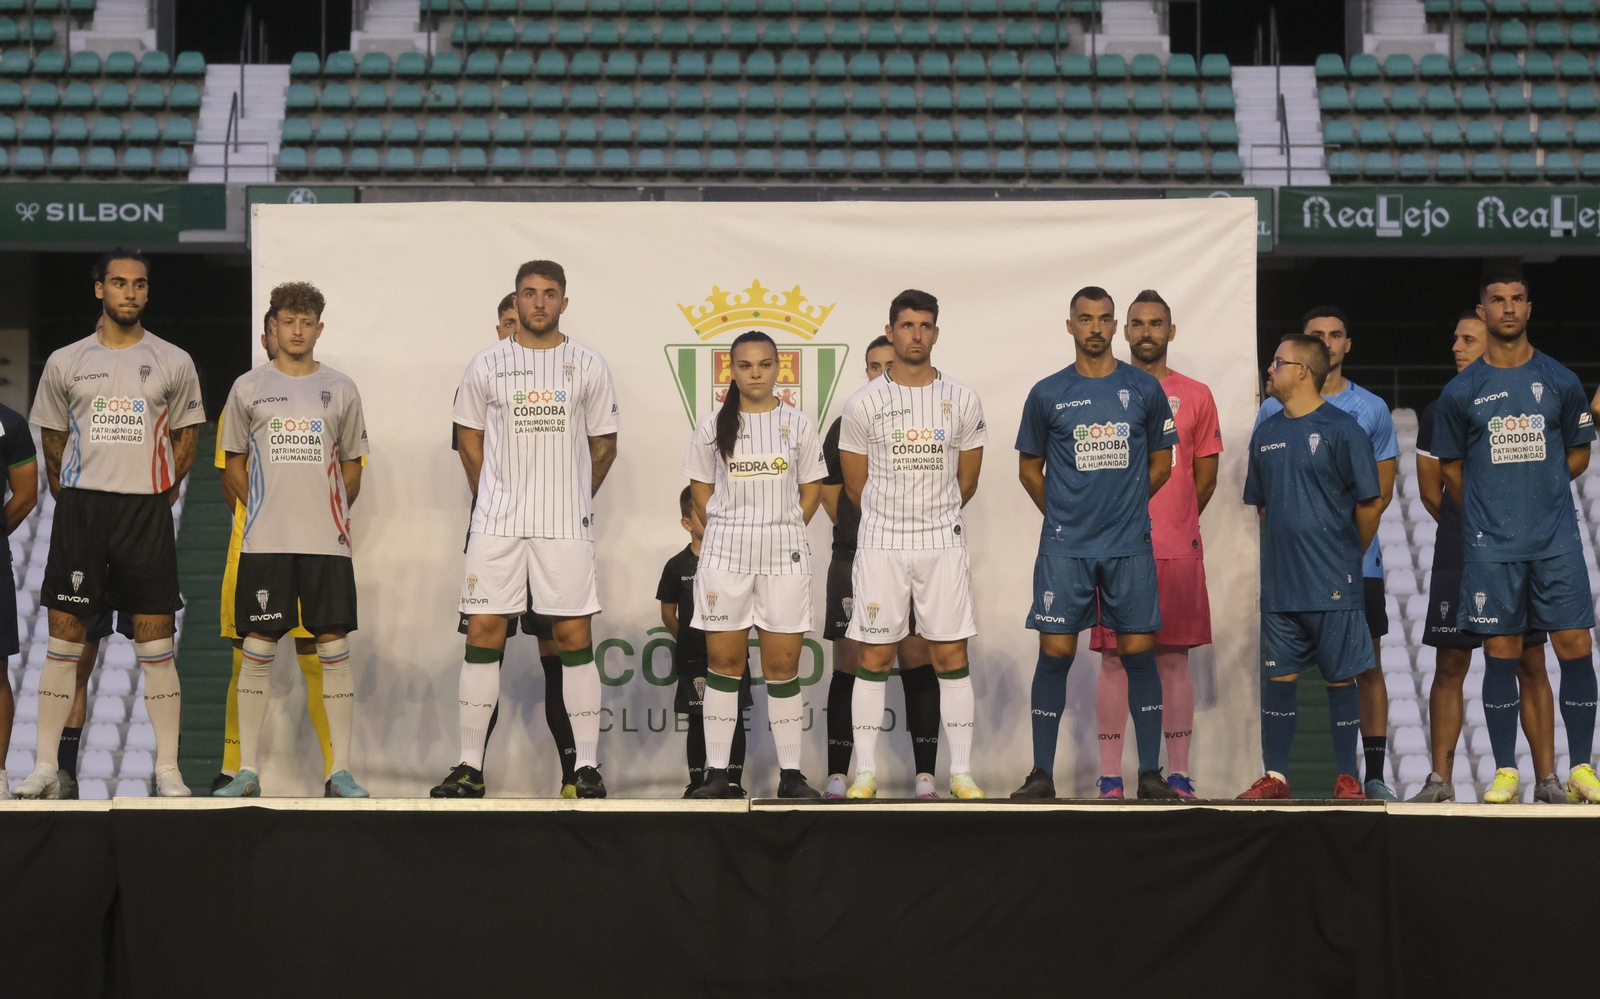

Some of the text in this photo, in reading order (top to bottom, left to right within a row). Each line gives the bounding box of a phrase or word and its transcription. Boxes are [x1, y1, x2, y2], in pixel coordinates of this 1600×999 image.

[46, 203, 164, 222] SILBON
[1303, 195, 1450, 237] ReaLejo
[74, 373, 109, 382] GIVOVA
[253, 397, 287, 406] GIVOVA
[1474, 391, 1509, 405] GIVOVA
[1055, 399, 1091, 410] GIVOVA
[513, 404, 566, 417] CÓRDOBA
[92, 413, 144, 426] CÓRDOBA
[270, 434, 322, 445] CÓRDOBA
[1491, 432, 1544, 445] CÓRDOBA
[892, 443, 944, 455] CÓRDOBA
[1076, 439, 1127, 452] CÓRDOBA
[1260, 442, 1286, 452] GIVOVA
[1493, 446, 1533, 454] PATRIMONIO
[1077, 453, 1118, 462] PATRIMONIO
[1504, 452, 1544, 460] HUMANIDAD
[1088, 460, 1127, 469] HUMANIDAD
[57, 594, 90, 604] GIVOVA
[250, 612, 283, 622] GIVOVA
